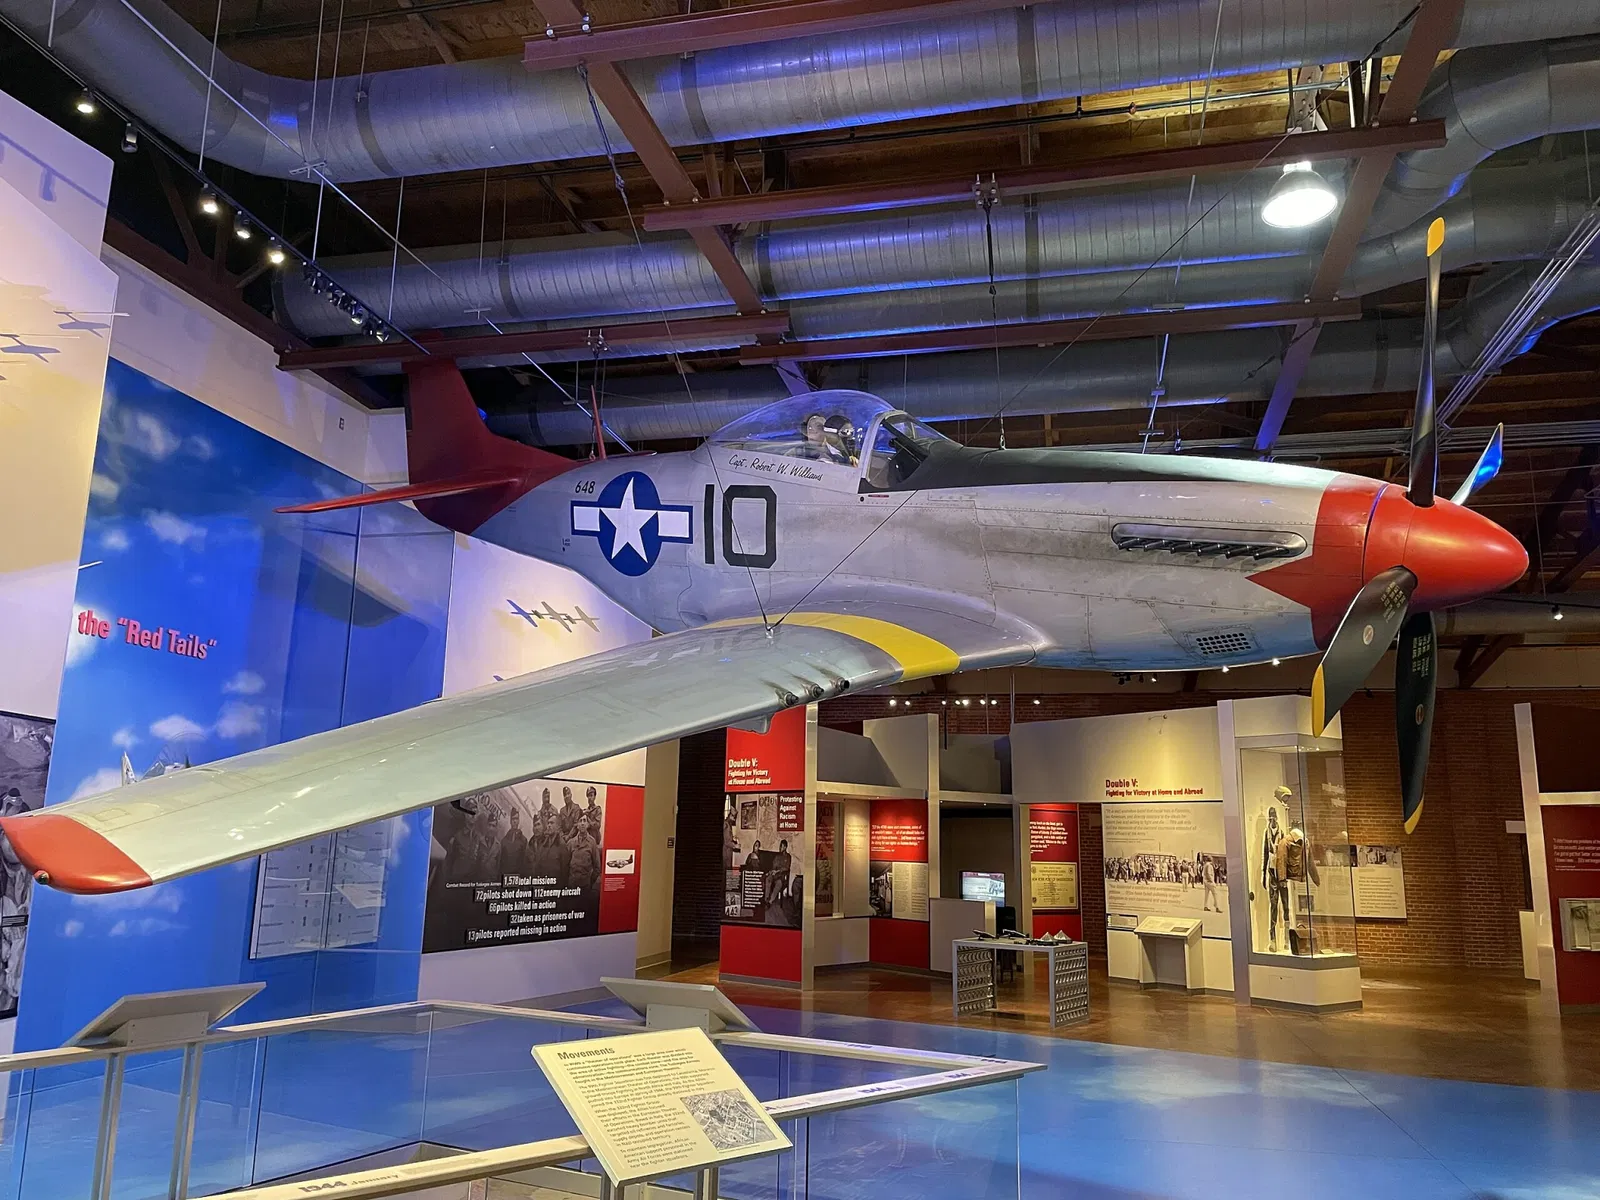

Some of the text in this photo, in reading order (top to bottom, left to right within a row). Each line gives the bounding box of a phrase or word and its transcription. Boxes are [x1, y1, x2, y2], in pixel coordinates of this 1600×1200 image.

[728, 454, 824, 482] Capt. Robert W. Williams
[575, 480, 596, 494] 648
[704, 484, 778, 568] 10
[77, 610, 111, 639] the
[728, 759, 751, 768] Double
[1106, 779, 1139, 788] Double V:
[1106, 789, 1125, 797] Fighting
[532, 875, 557, 885] missions
[501, 889, 515, 899] shot
[515, 889, 532, 898] down
[561, 886, 581, 896] aircraft
[514, 901, 531, 911] killed
[532, 900, 538, 910] in
[539, 900, 556, 909] action
[534, 914, 542, 922] as
[541, 911, 568, 924] prisoners
[574, 911, 585, 919] war
[493, 926, 520, 940] reported
[520, 925, 542, 936] missing
[542, 924, 549, 934] in
[549, 923, 567, 933] action
[557, 1047, 615, 1060] Movements
